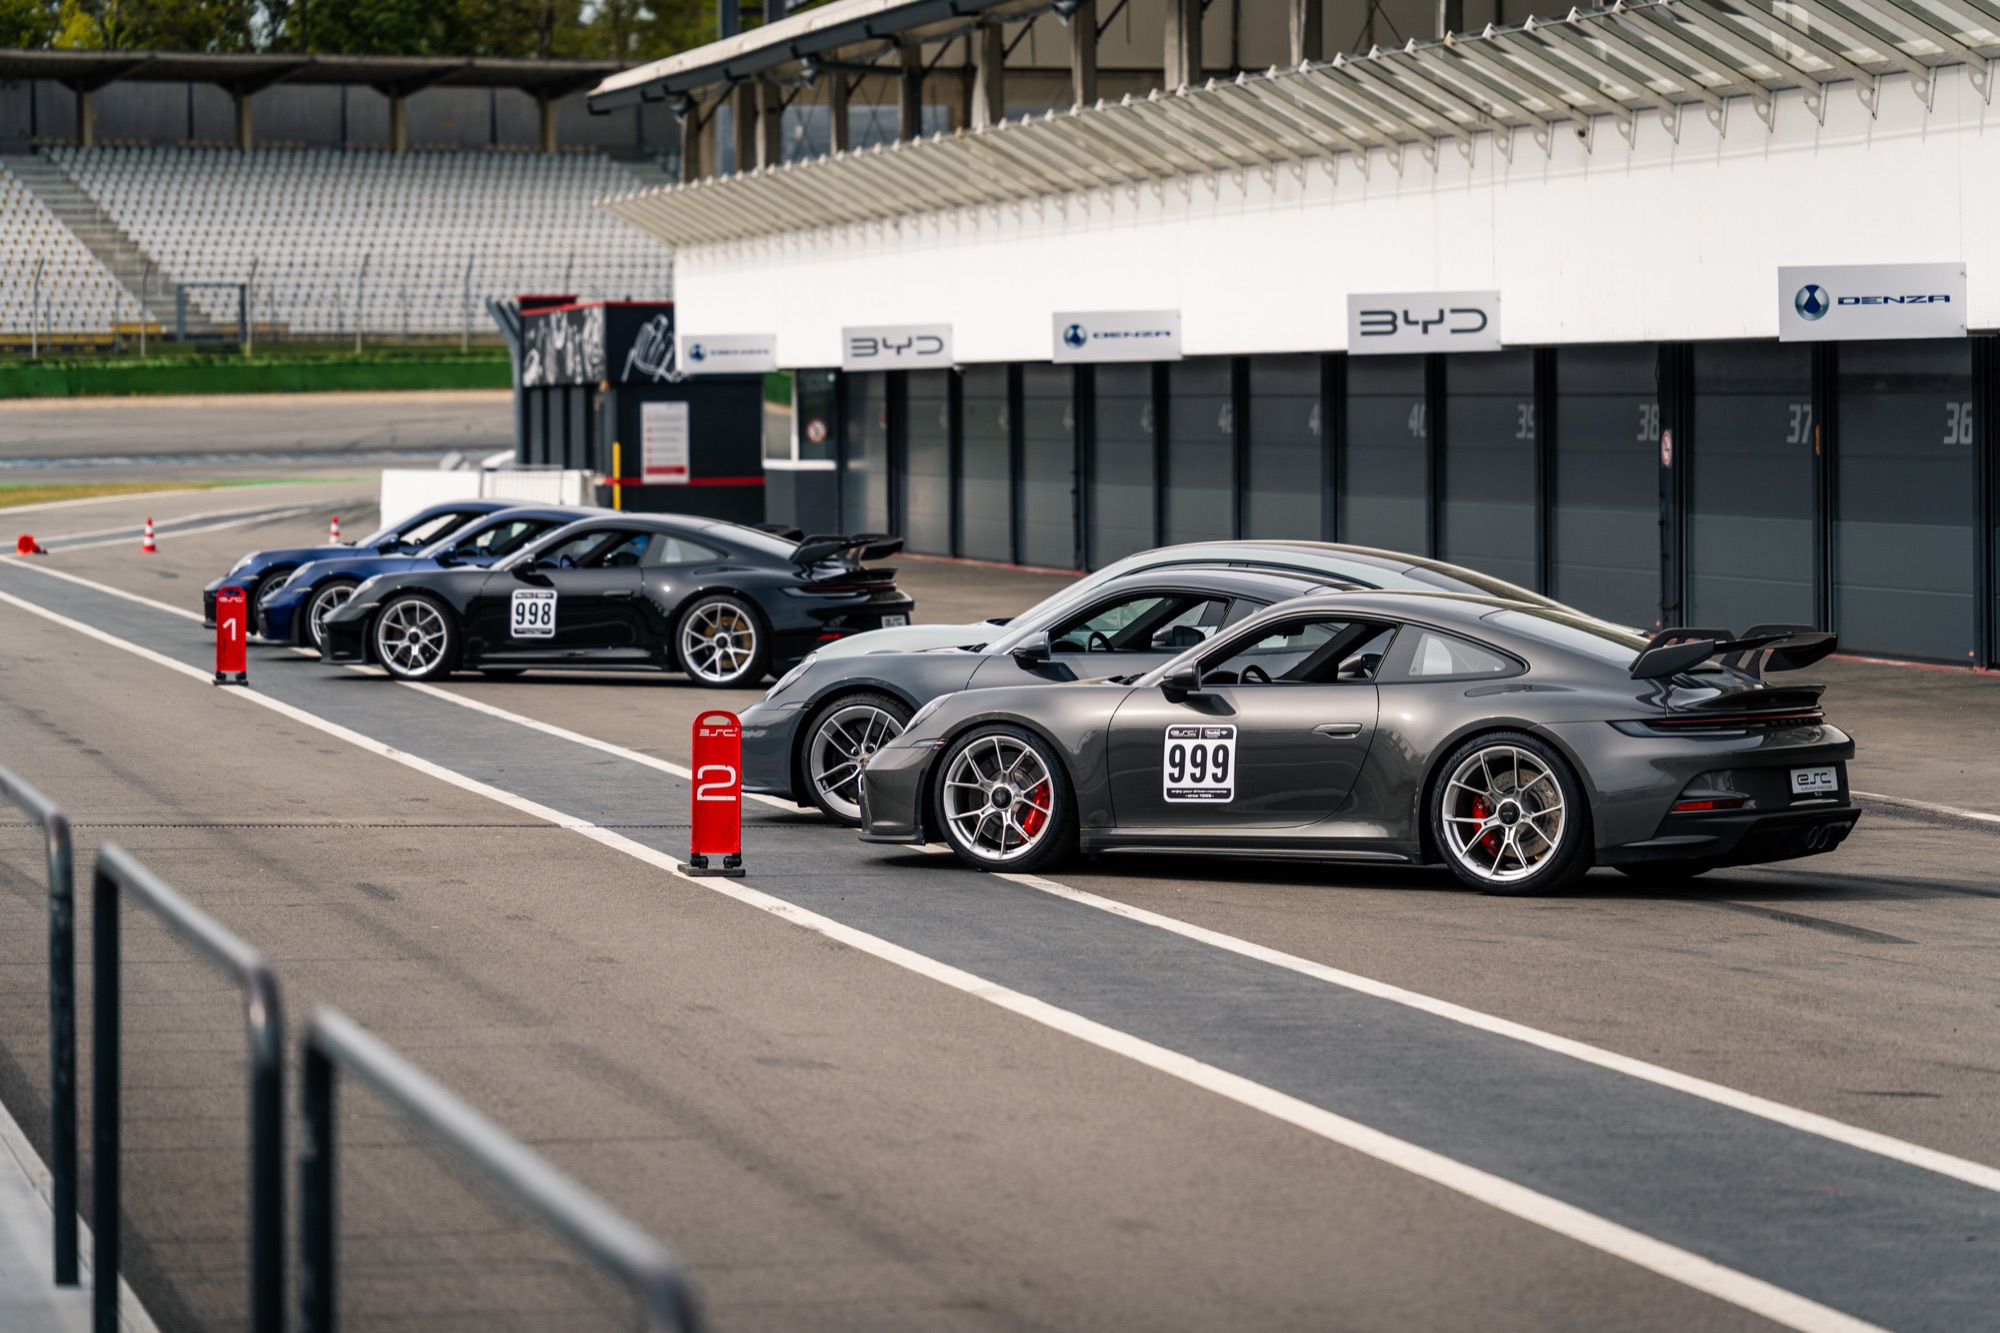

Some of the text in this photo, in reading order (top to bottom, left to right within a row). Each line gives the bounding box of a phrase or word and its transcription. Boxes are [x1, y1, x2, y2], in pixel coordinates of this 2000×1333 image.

[1838, 294, 1950, 306] DENZA
[1360, 308, 1488, 336] BYD
[850, 335, 944, 357] BYD
[1515, 404, 1535, 439] 39
[1637, 404, 1660, 441] 38
[1786, 404, 1812, 444] 37
[1943, 402, 1973, 445] 36
[515, 602, 552, 625] 998
[222, 618, 237, 641] 1
[1168, 743, 1230, 783] 999
[697, 764, 737, 801] 2
[1797, 772, 1831, 786] esc
